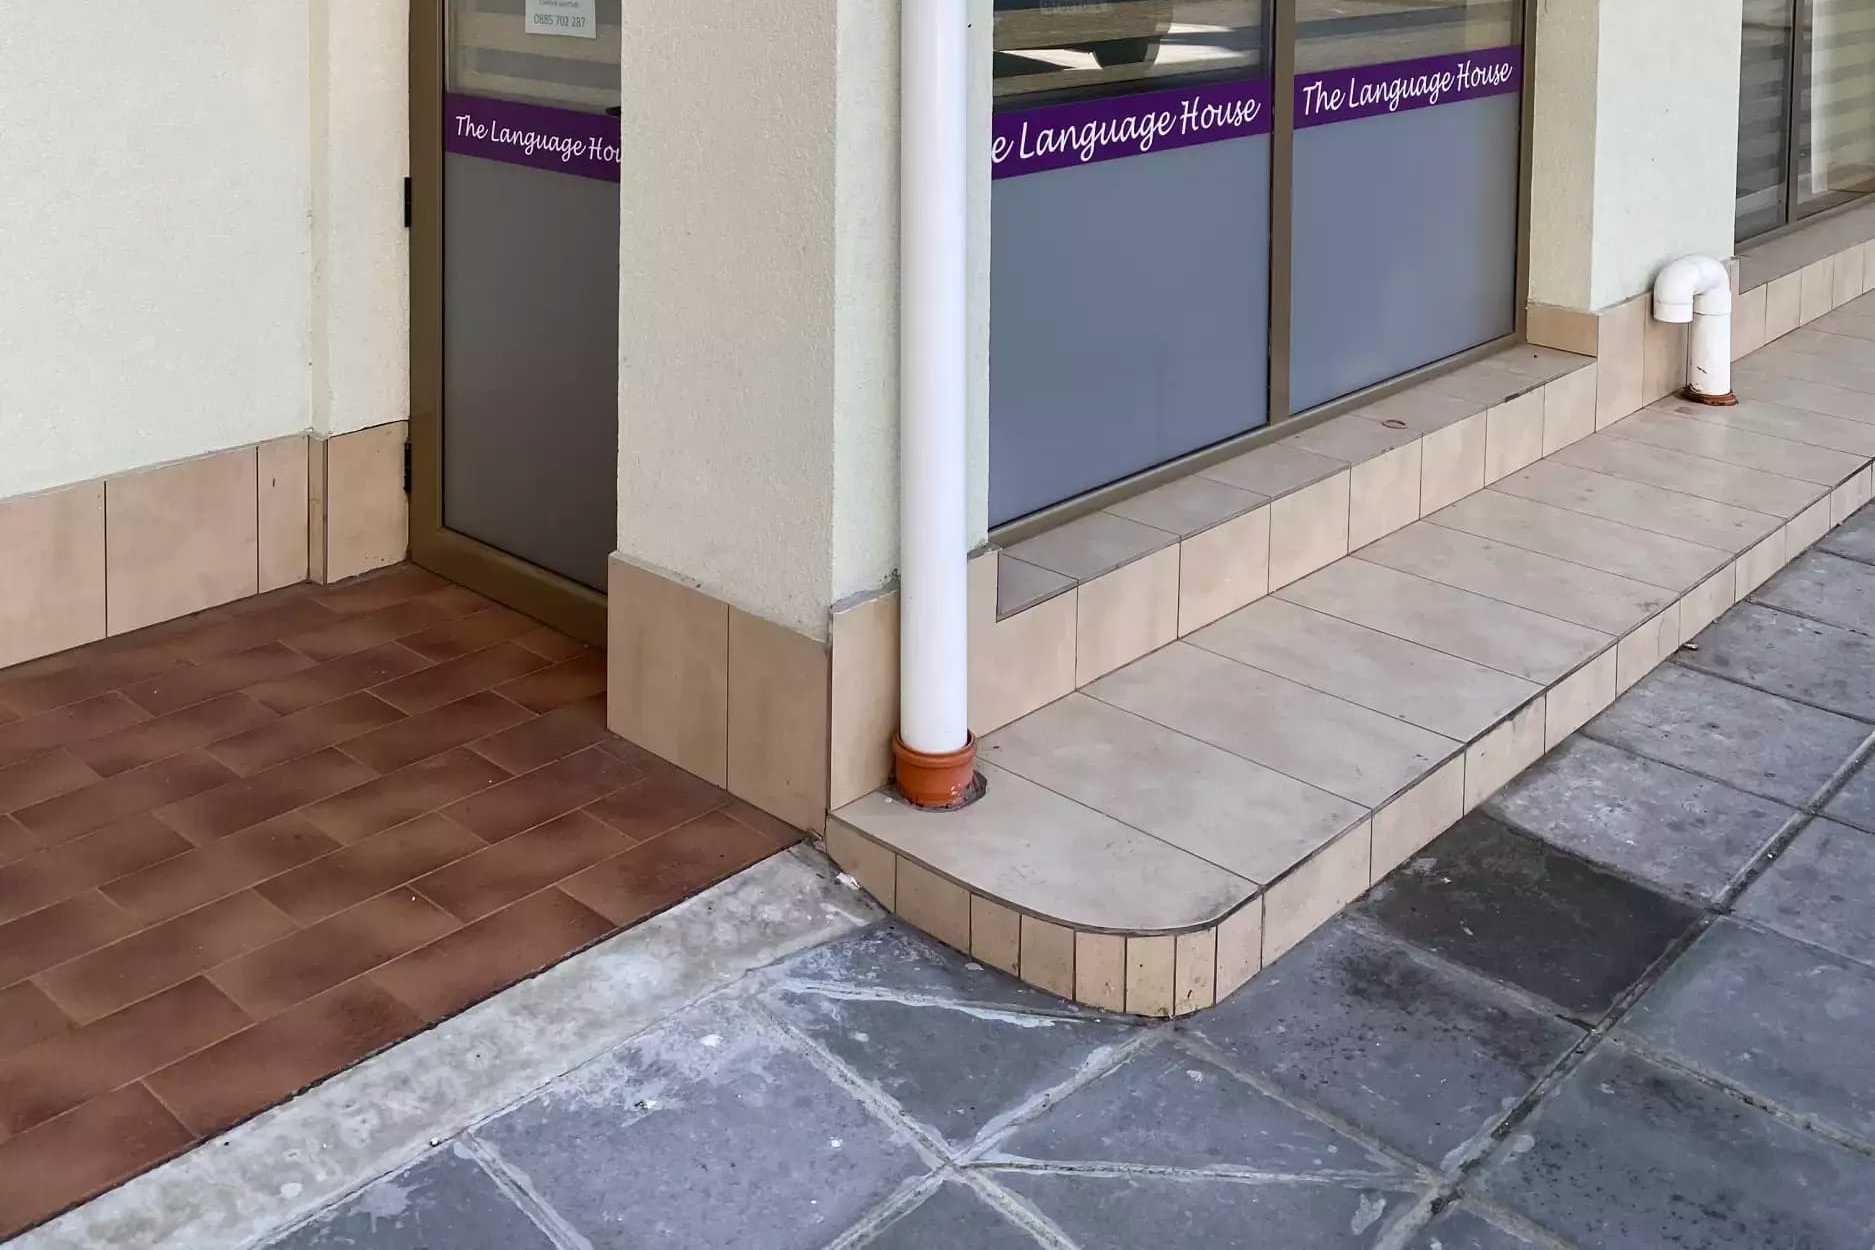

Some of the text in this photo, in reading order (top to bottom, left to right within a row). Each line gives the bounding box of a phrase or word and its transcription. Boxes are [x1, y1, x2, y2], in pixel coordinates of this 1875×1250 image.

[1303, 60, 1512, 115] The Language House
[456, 114, 488, 139] The
[491, 120, 587, 163] Language
[1019, 111, 1177, 161] Language
[1180, 96, 1261, 135] House
